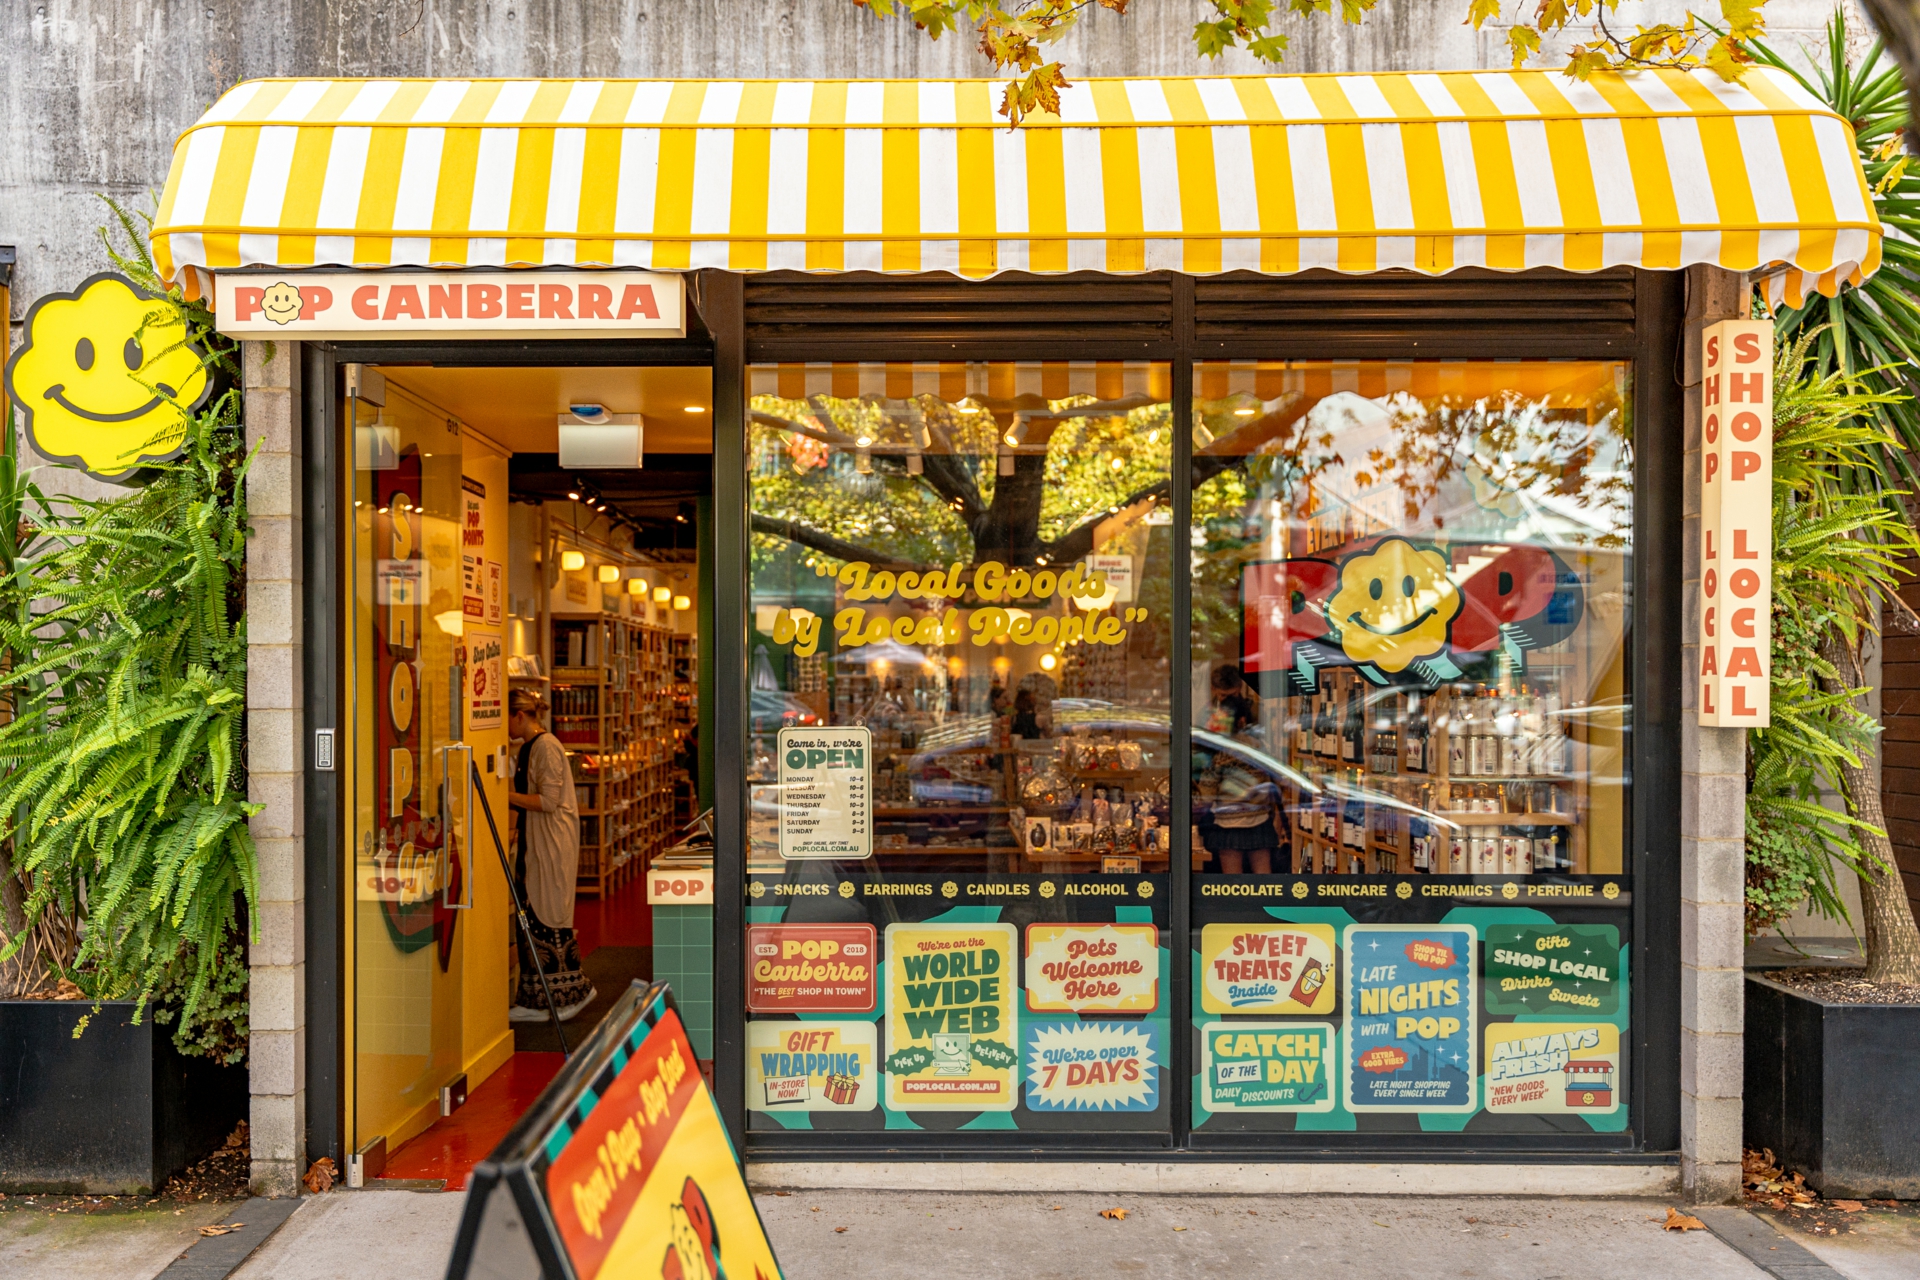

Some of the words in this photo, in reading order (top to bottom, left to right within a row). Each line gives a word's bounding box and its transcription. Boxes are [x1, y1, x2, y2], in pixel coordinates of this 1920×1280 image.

[351, 283, 660, 321] CANBERRA
[1705, 335, 1720, 484] SHOP
[1729, 333, 1764, 481] SHOP
[447, 418, 458, 436] G12
[467, 511, 480, 527] POP
[463, 529, 484, 546] POINTS
[1307, 505, 1347, 557] EVERY
[815, 561, 967, 601] “Local
[974, 560, 1107, 599] Goods
[772, 608, 823, 657] by
[833, 606, 962, 646] Local
[969, 606, 1148, 647] People”
[1701, 530, 1717, 714] LOCAL
[1725, 529, 1763, 717] LOCAL
[390, 492, 415, 818] SHOP
[786, 739, 816, 748] Come
[817, 739, 830, 749] in,
[833, 739, 863, 748] we're
[786, 749, 864, 769] OPEN
[654, 880, 704, 896] POP
[774, 884, 830, 895] SNACKS
[864, 884, 933, 895] EARRINGS
[966, 884, 1030, 896] CANDLES
[1064, 884, 1128, 895] ALCOHOL
[1201, 884, 1283, 896] CHOCOLATE
[1317, 884, 1387, 896] SKINCARE
[1421, 885, 1493, 896] CERAMICS
[1528, 885, 1593, 896] PERFUME
[782, 940, 839, 960] POP
[846, 946, 864, 954] 2018
[917, 941, 951, 951] We're
[968, 937, 985, 947] the
[1067, 938, 1118, 960] Pets
[1232, 933, 1308, 957] SWEET
[1413, 943, 1435, 955] SHOP
[1436, 948, 1448, 958] TIL
[1535, 935, 1571, 951] Gifts
[903, 949, 1000, 981] WORLD
[1413, 952, 1429, 962] YOU
[1430, 955, 1447, 965] POP
[1493, 949, 1546, 970] SHOP
[1549, 958, 1610, 982] LOCAL
[754, 959, 869, 983] Canberra
[1042, 959, 1143, 982] Welcome
[1214, 959, 1292, 983] TREATS
[1360, 965, 1397, 983] LATE
[754, 987, 776, 996] “THE
[777, 987, 795, 997] BEST
[797, 987, 822, 996] SHOP
[824, 987, 833, 996] IN
[835, 987, 866, 996] TOWN”
[903, 977, 1000, 1009] WIDE
[1064, 979, 1121, 1001] Here
[1228, 982, 1278, 999] Inside
[1500, 974, 1553, 991] Drinks
[1360, 979, 1460, 1015] NIGHTS
[1548, 987, 1601, 1008] Sweets
[903, 1005, 1000, 1039] WEB
[1361, 1023, 1389, 1036] WITH
[1395, 1016, 1460, 1039] POP
[787, 1031, 834, 1052] GIFT
[1214, 1034, 1319, 1058] CATCH
[1491, 1028, 1599, 1062] ALWAYS
[894, 1056, 914, 1068] PICK
[914, 1053, 926, 1064] UP
[975, 1044, 1012, 1064] DELIVERY
[1042, 1047, 1097, 1064] We're
[1099, 1045, 1139, 1063] open
[1363, 1059, 1383, 1068] GOOD
[1384, 1056, 1404, 1066] VIBES
[1371, 1051, 1394, 1060] EXTRA
[761, 1053, 860, 1077] WRAPPING
[1042, 1065, 1059, 1088] 7
[1066, 1058, 1140, 1086] DAYS
[1221, 1067, 1234, 1078] OF
[1238, 1065, 1257, 1076] THE
[1267, 1060, 1319, 1083] DAY
[1491, 1050, 1571, 1080] FRESH
[769, 1079, 806, 1090] IN-STORE
[777, 1089, 799, 1099] NOW!
[906, 1082, 997, 1091] POPLOCAL.COM.AU
[1215, 1087, 1242, 1099] DAILY
[1242, 1088, 1295, 1102] DISCOUNTS
[1369, 1081, 1388, 1089] LATE
[1389, 1081, 1413, 1089] NIGHT
[1414, 1081, 1451, 1089] SHOPPING
[1374, 1089, 1398, 1097] EVERY
[1399, 1089, 1425, 1097] SINGLE
[1426, 1089, 1447, 1097] WEEK
[1516, 1080, 1545, 1092] GOODS
[1491, 1095, 1519, 1107] EVERY
[606, 1117, 642, 1181] Days
[597, 1144, 617, 1191] 7
[572, 1166, 612, 1240] Open
